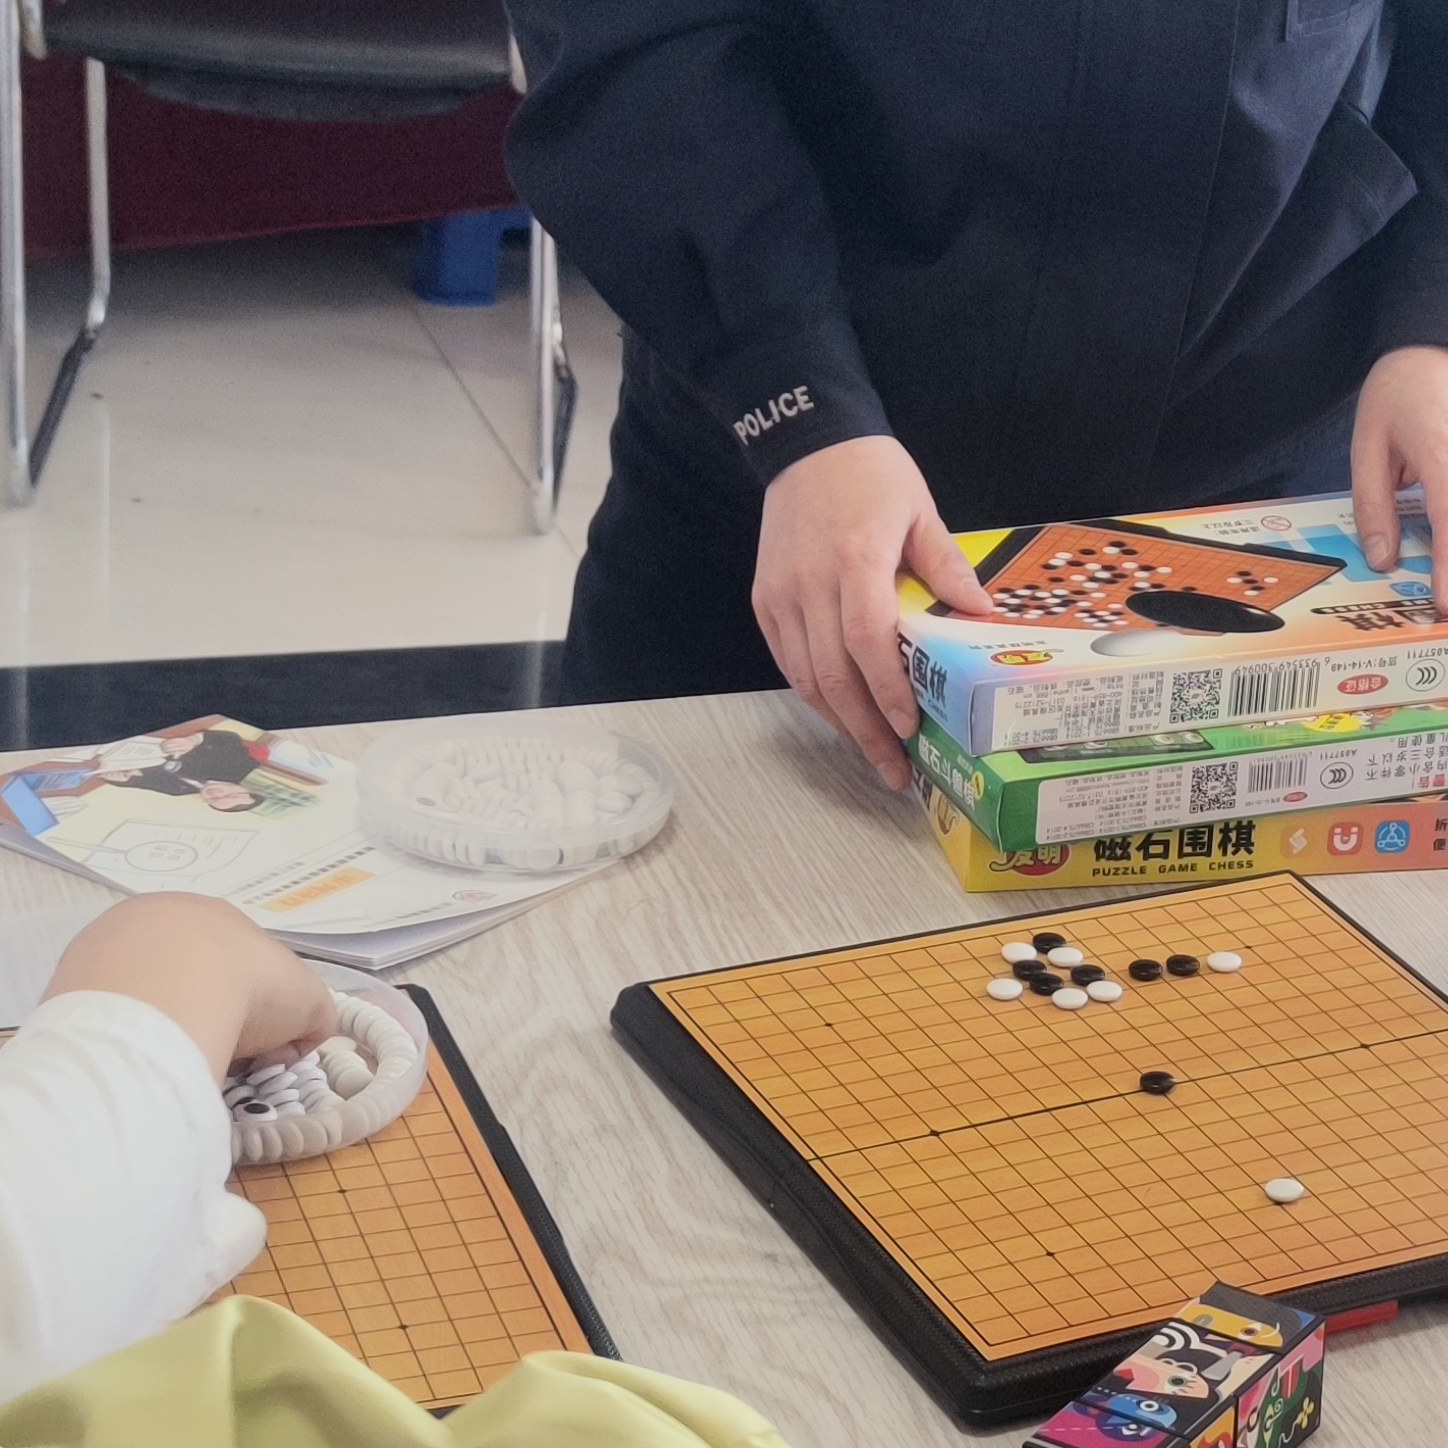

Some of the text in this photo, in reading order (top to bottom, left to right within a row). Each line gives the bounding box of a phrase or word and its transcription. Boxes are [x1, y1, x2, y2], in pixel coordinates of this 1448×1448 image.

[732, 385, 815, 446] POLICE
[1342, 675, 1383, 693] 合格证
[1367, 744, 1448, 765] 适合三岁以下
[1365, 758, 1448, 781] 内含小零件不
[1093, 820, 1257, 863] 磁石围棋
[1092, 860, 1254, 877] PUZZLE GAME CHESS
